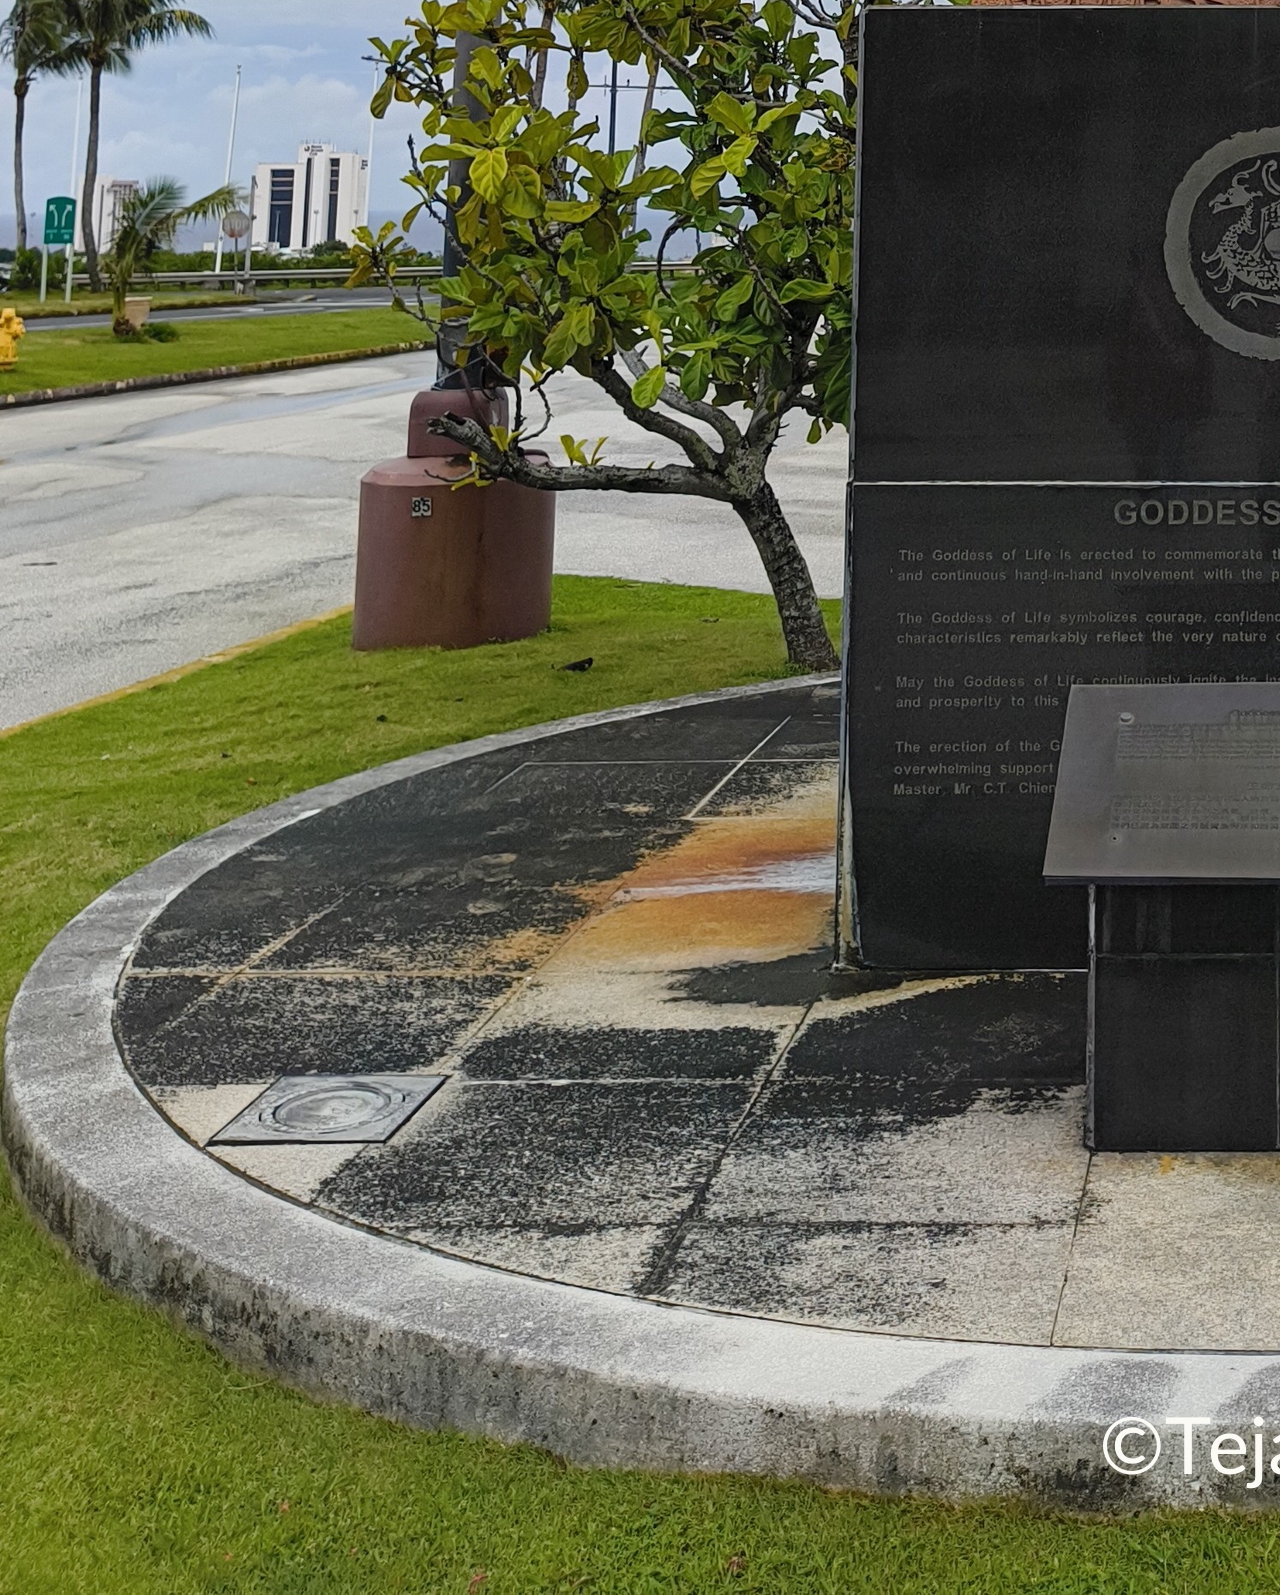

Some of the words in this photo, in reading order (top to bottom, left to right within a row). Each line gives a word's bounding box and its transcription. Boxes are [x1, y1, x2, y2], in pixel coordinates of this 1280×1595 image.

[411, 499, 431, 513] 85
[898, 549, 925, 561] The
[931, 549, 994, 561] Goddess
[1001, 549, 1017, 561] of
[1024, 549, 1052, 561] Life
[1059, 549, 1072, 561] is
[1079, 549, 1134, 561] erected
[1141, 549, 1157, 561] to
[1164, 549, 1264, 561] commemorate
[897, 569, 924, 581] and
[930, 569, 1007, 581] continuous
[1014, 569, 1103, 581] hand-in-hand
[1110, 569, 1195, 581] involvement
[1203, 569, 1234, 581] with
[1240, 569, 1264, 581] the
[896, 611, 923, 624] The
[931, 611, 993, 624] Goddess
[1000, 611, 1017, 624] of
[1024, 611, 1052, 624] Life
[1059, 611, 1138, 627] symbolizes
[1144, 614, 1208, 627] courage,
[896, 631, 1002, 643] characteristics
[1009, 631, 1088, 647] remarkably
[1096, 631, 1144, 643] reflect
[1151, 631, 1174, 643] the
[1181, 633, 1215, 647] very
[1221, 631, 1267, 643] nature
[895, 675, 925, 692] May
[933, 675, 955, 688] the
[963, 675, 1025, 688] Goddess
[1033, 675, 1049, 688] of
[1057, 675, 1084, 687] Life
[895, 694, 922, 707] and
[928, 694, 1003, 711] prosperity
[1010, 694, 1026, 707] to
[1033, 694, 1060, 707] this
[894, 740, 921, 753] The
[928, 740, 988, 753] erection
[995, 740, 1011, 753] of
[1018, 740, 1041, 753] the
[892, 762, 992, 778] overwhelming
[999, 762, 1053, 778] support
